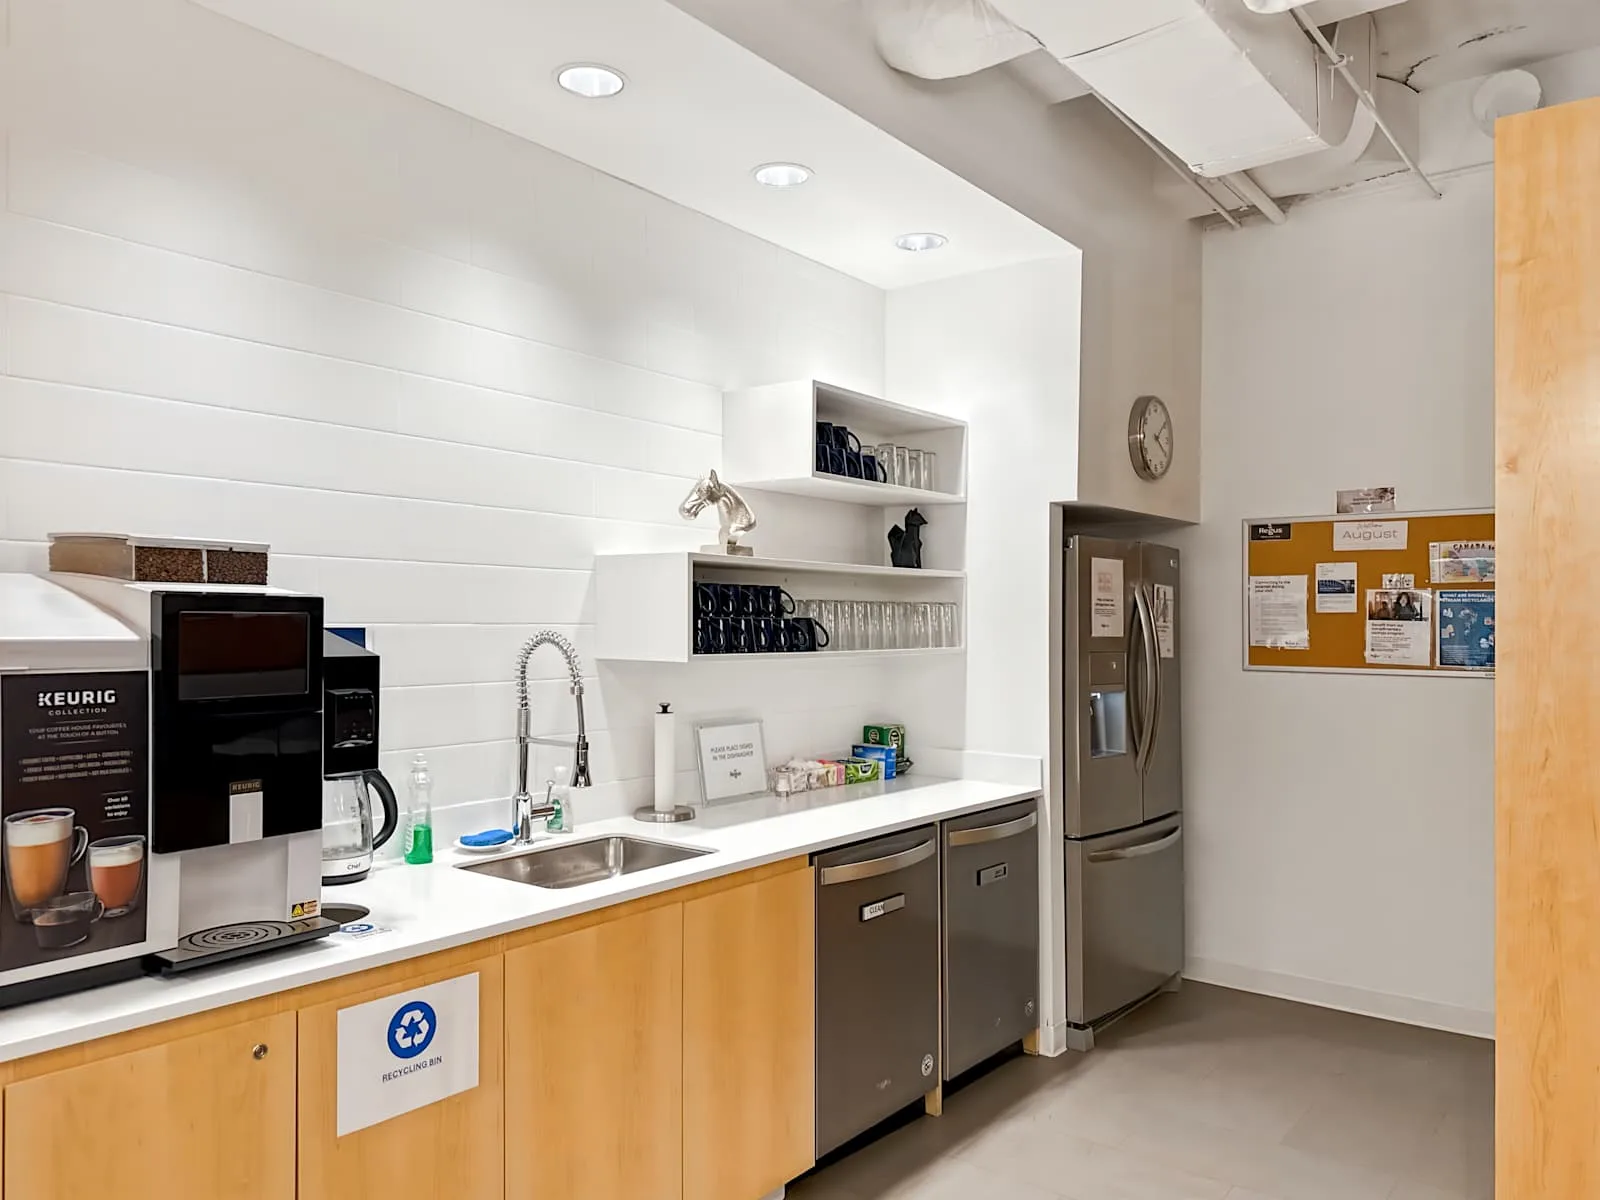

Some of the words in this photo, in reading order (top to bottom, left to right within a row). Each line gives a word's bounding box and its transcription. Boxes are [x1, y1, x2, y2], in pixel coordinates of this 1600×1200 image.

[1258, 527, 1282, 536] Regus
[1342, 529, 1398, 541] August
[1453, 543, 1486, 552] CANADA
[38, 690, 115, 706] KEURIG
[48, 708, 107, 716] COLLECTION
[232, 782, 260, 790] KEURIG
[347, 862, 361, 870] Chef
[869, 903, 885, 914] CLEAN
[382, 1061, 428, 1083] RECYCLING
[429, 1056, 442, 1068] BIN
